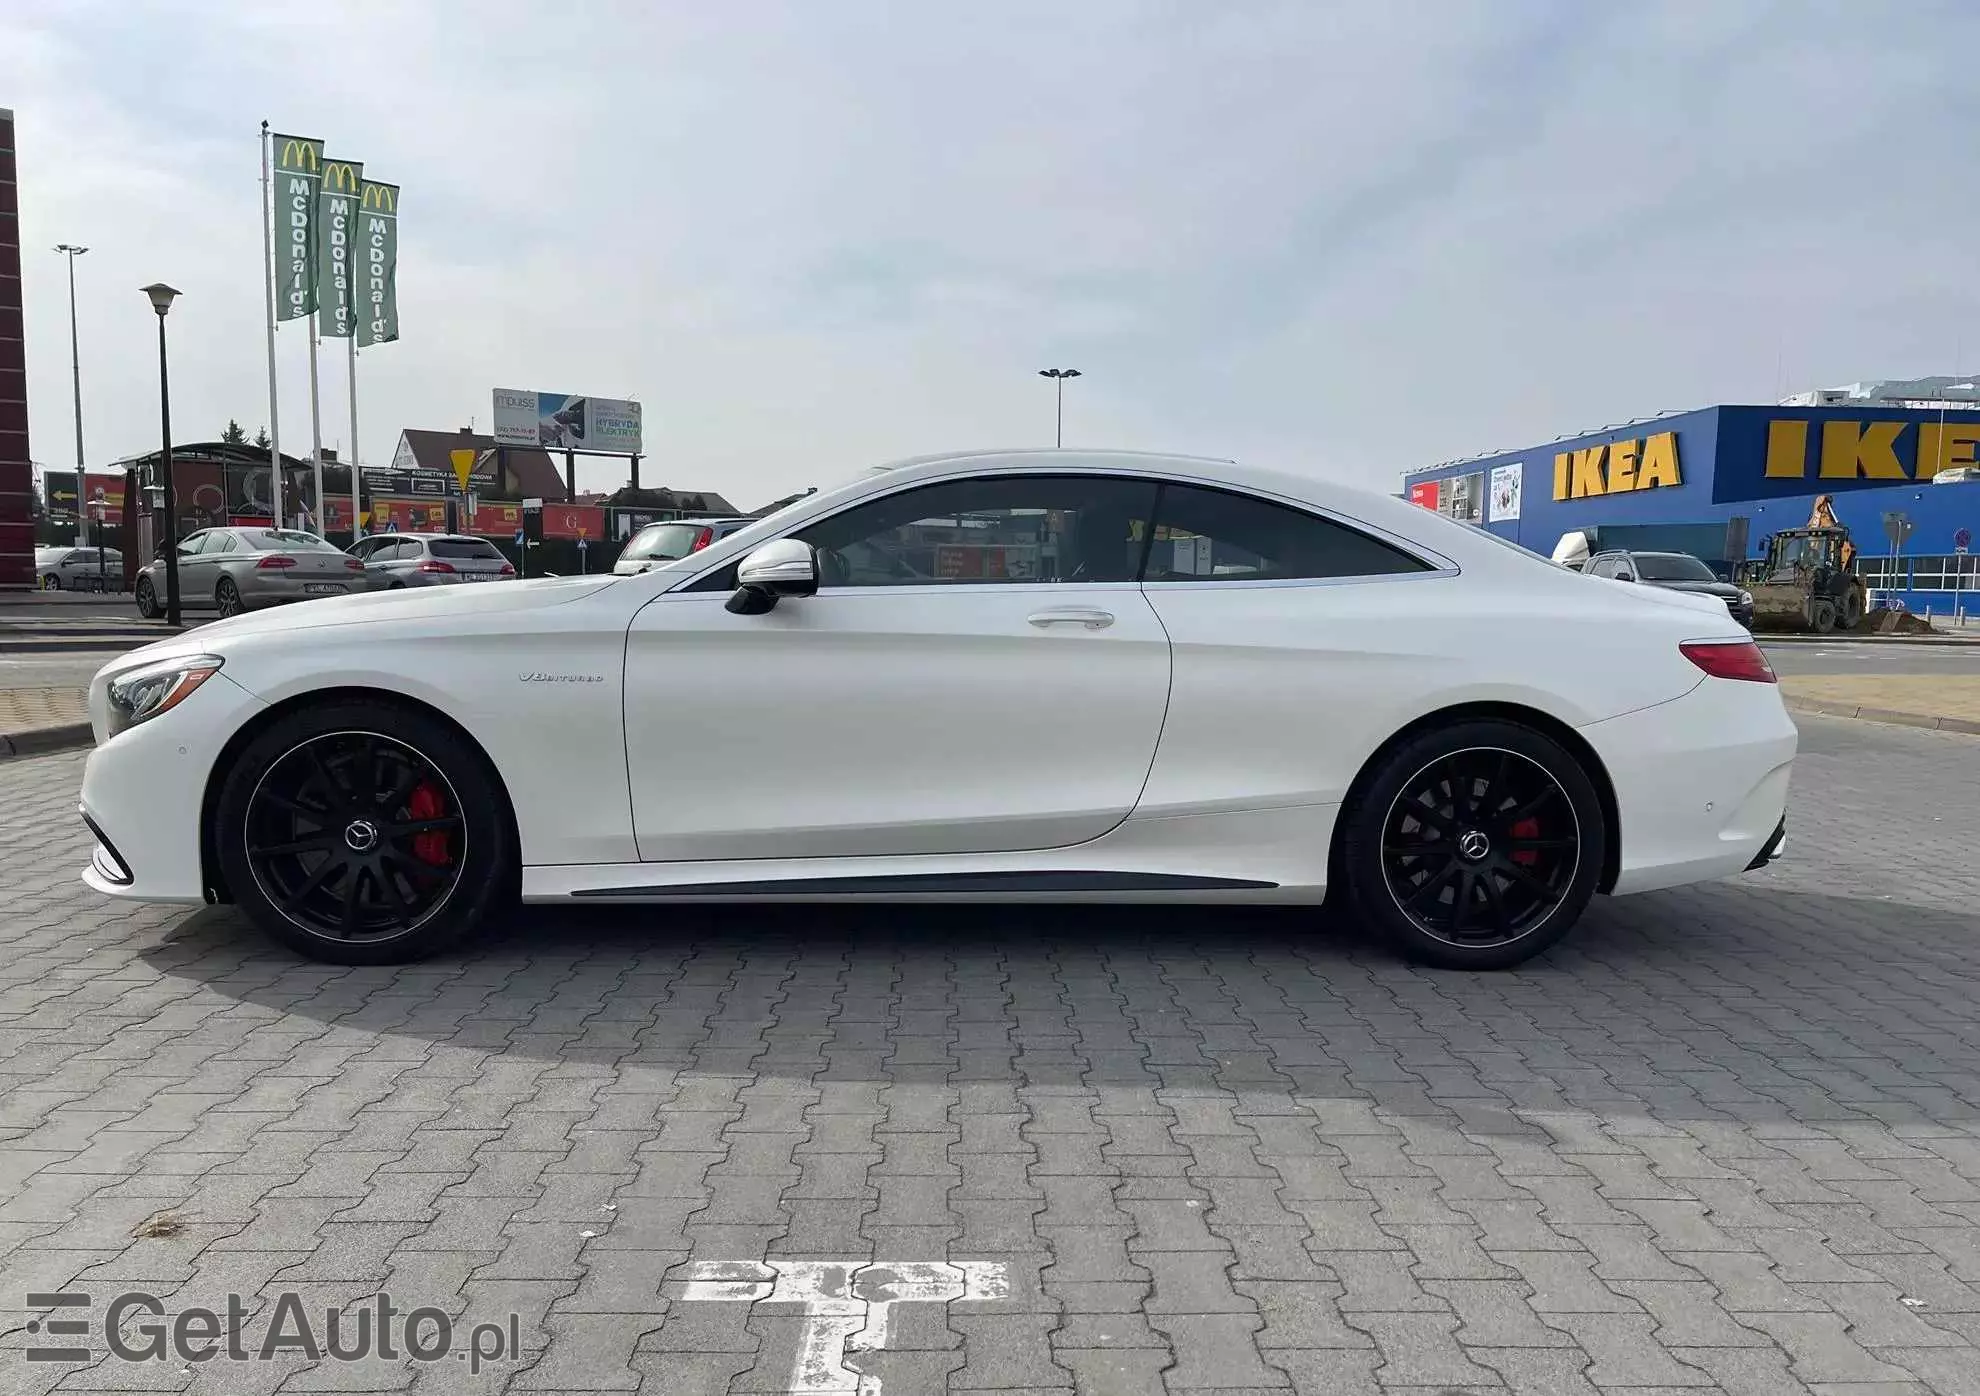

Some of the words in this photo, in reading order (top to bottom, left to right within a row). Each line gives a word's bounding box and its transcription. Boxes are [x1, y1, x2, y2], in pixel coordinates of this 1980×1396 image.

[289, 178, 310, 318] McDonald's
[330, 199, 349, 335] McDonald's
[369, 218, 387, 342] McDonald's
[1552, 431, 1682, 501] IKEA
[1765, 420, 1980, 480] IKE
